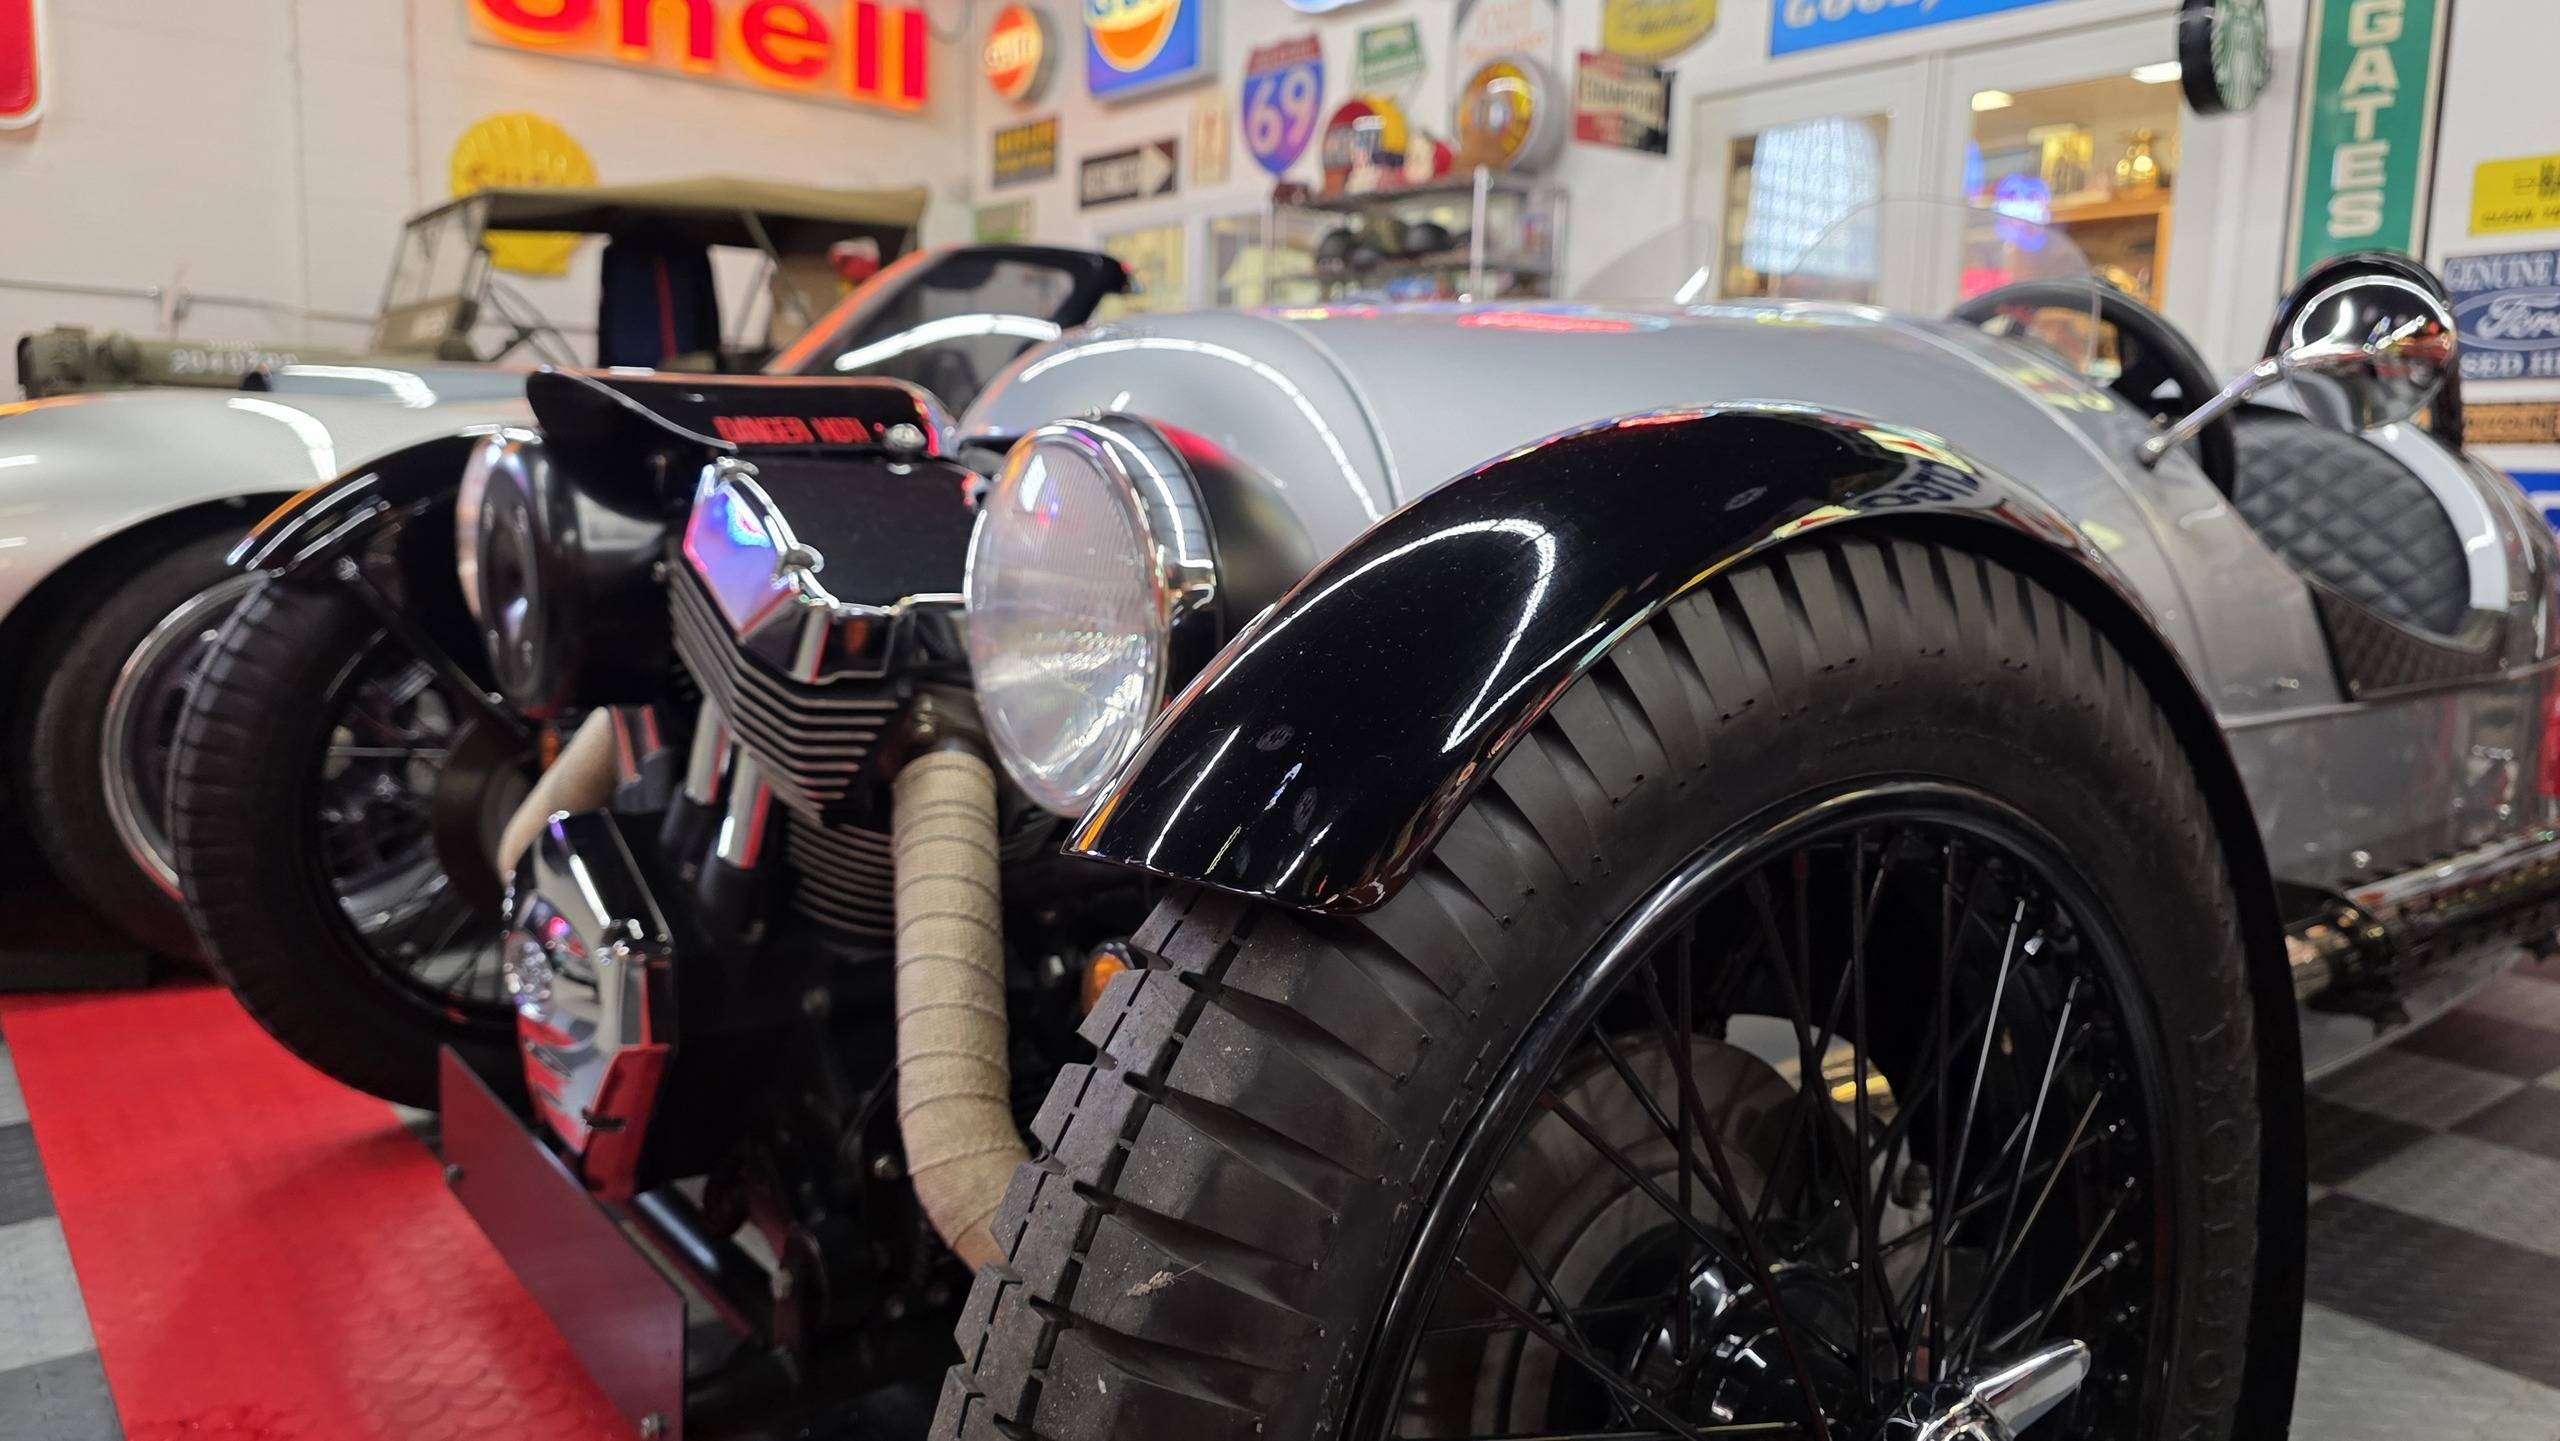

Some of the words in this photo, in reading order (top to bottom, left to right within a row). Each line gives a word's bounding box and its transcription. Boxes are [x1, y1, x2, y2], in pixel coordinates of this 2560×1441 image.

[1249, 65, 1317, 156] 69
[2327, 0, 2405, 239] GATES
[2459, 352, 2524, 378] SED
